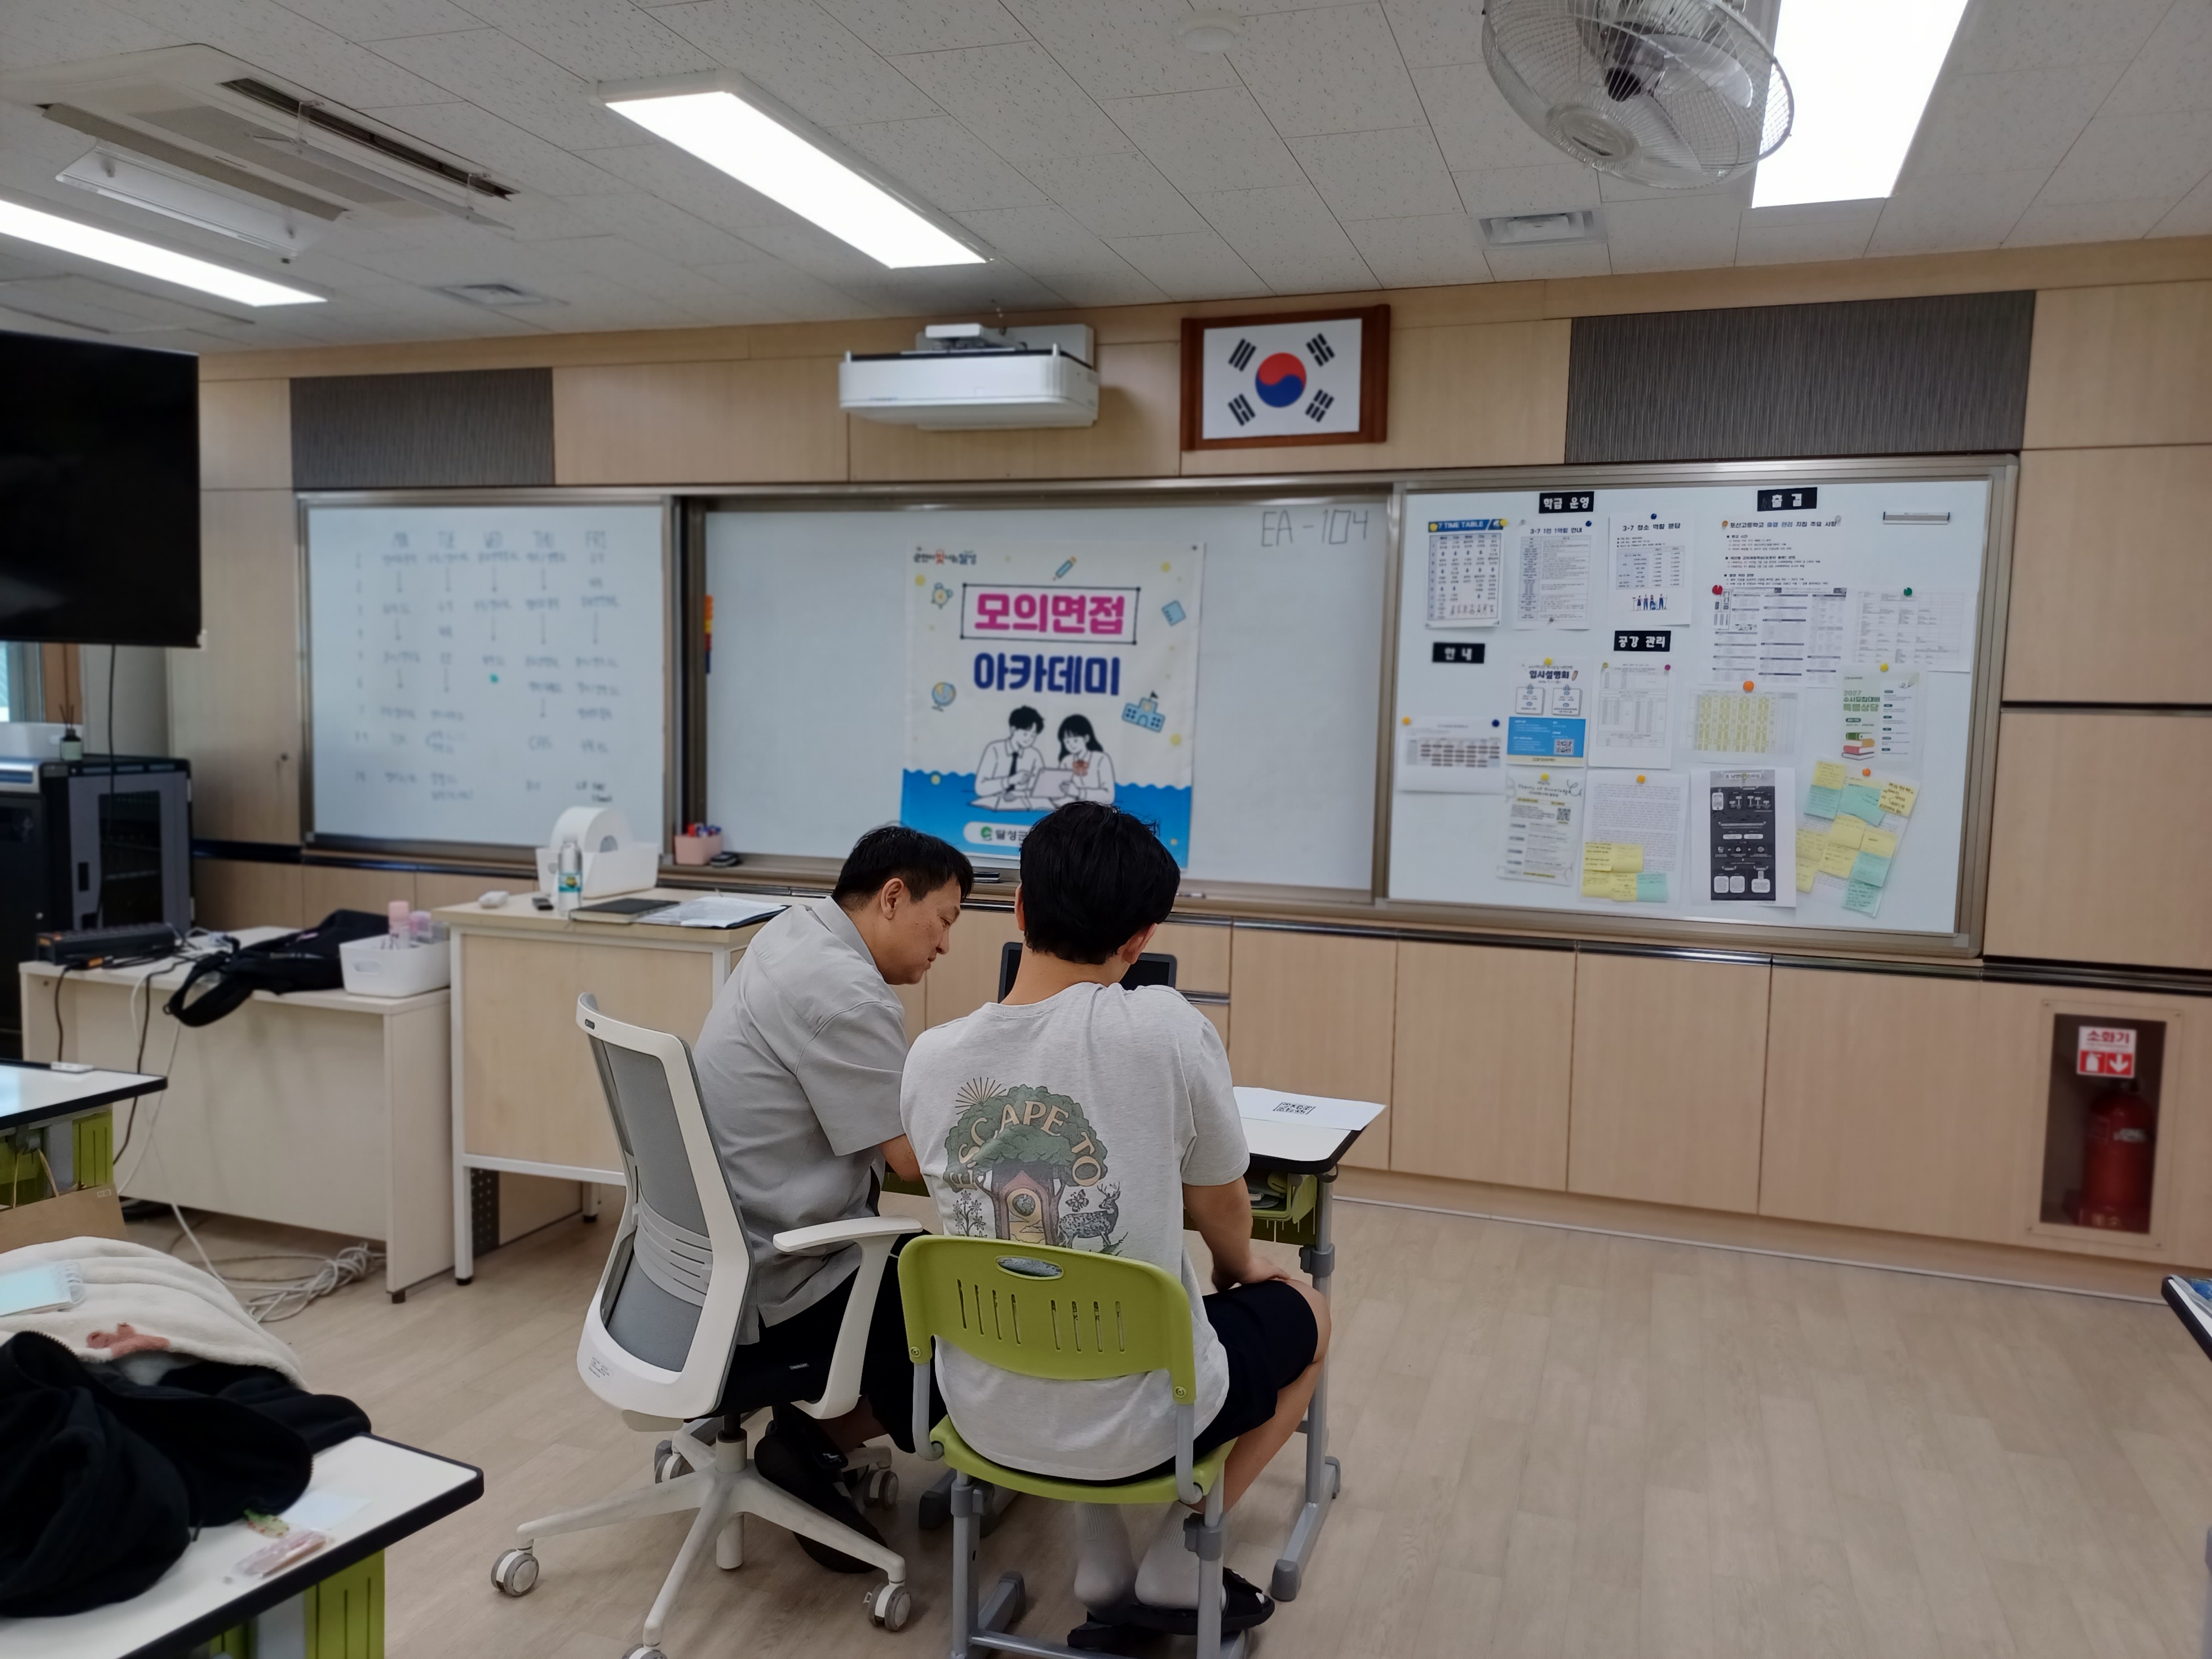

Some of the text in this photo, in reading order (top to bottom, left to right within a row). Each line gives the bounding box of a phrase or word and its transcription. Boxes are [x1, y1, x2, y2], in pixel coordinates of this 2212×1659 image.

[1543, 497, 1590, 509] 학급 운영
[974, 593, 1125, 635] 모의면접
[1618, 636, 1666, 648] 공강 관리
[974, 653, 1120, 696] 아카데미
[1529, 670, 1569, 680] 입시설명회
[2086, 1030, 2130, 1045] 소화기
[949, 1100, 1102, 1191] ESCAPE TO
